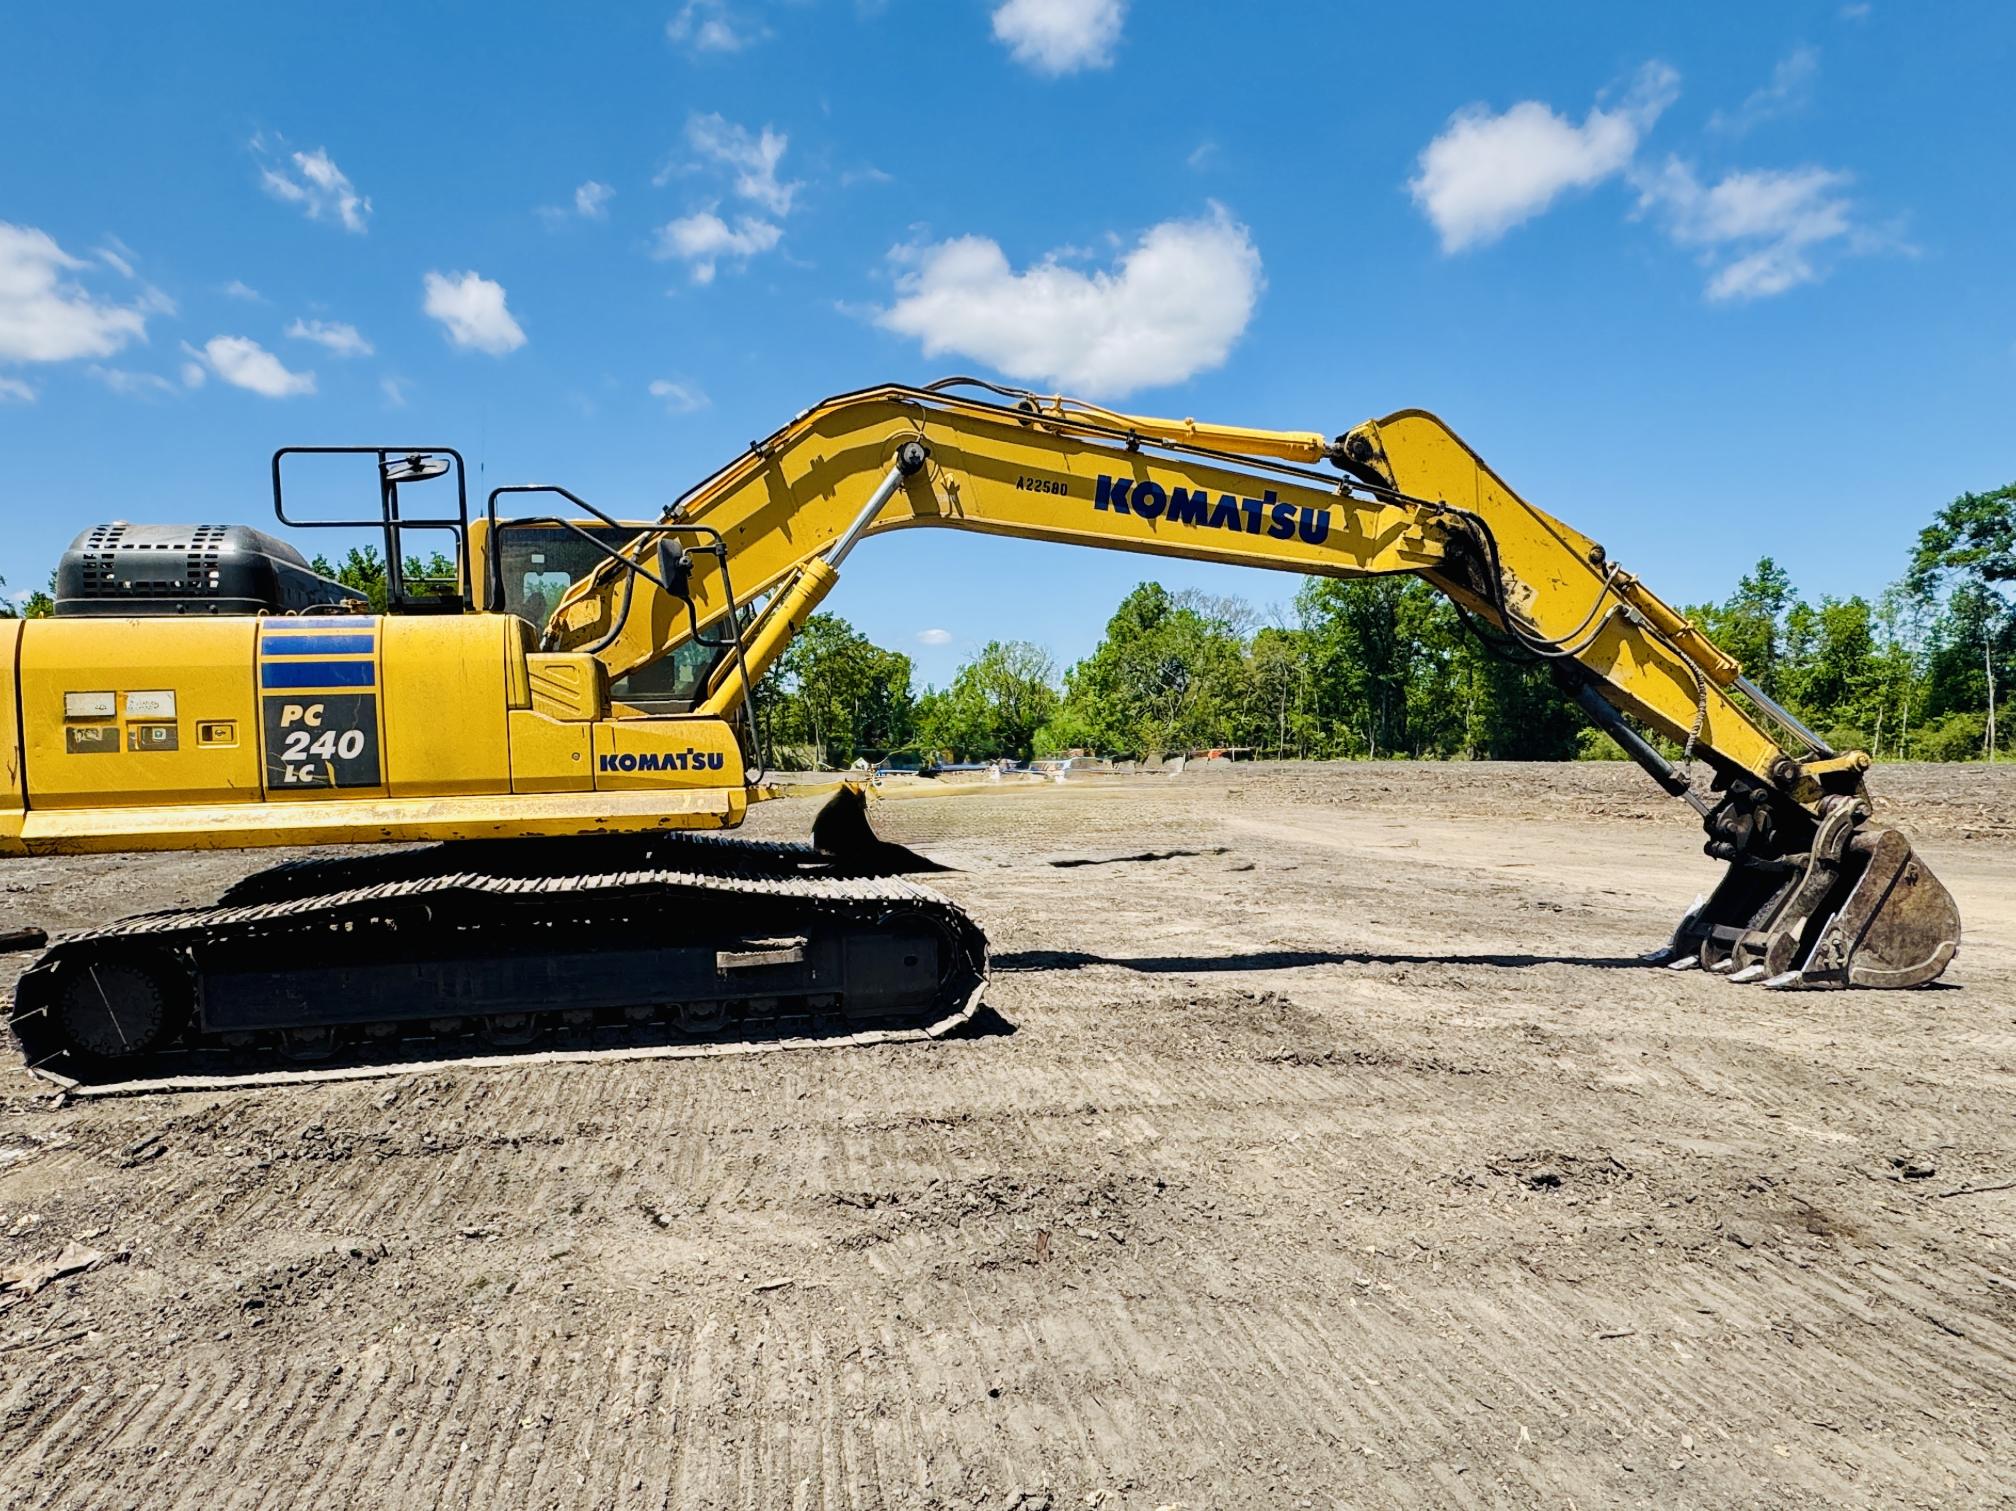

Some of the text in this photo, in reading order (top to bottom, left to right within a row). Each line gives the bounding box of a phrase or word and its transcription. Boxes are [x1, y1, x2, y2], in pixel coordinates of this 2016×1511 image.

[1094, 474, 1331, 545] KOMATSU
[280, 703, 325, 728] PC
[280, 729, 365, 761] 240
[599, 747, 724, 772] KOMATSU
[283, 763, 315, 783] LC
